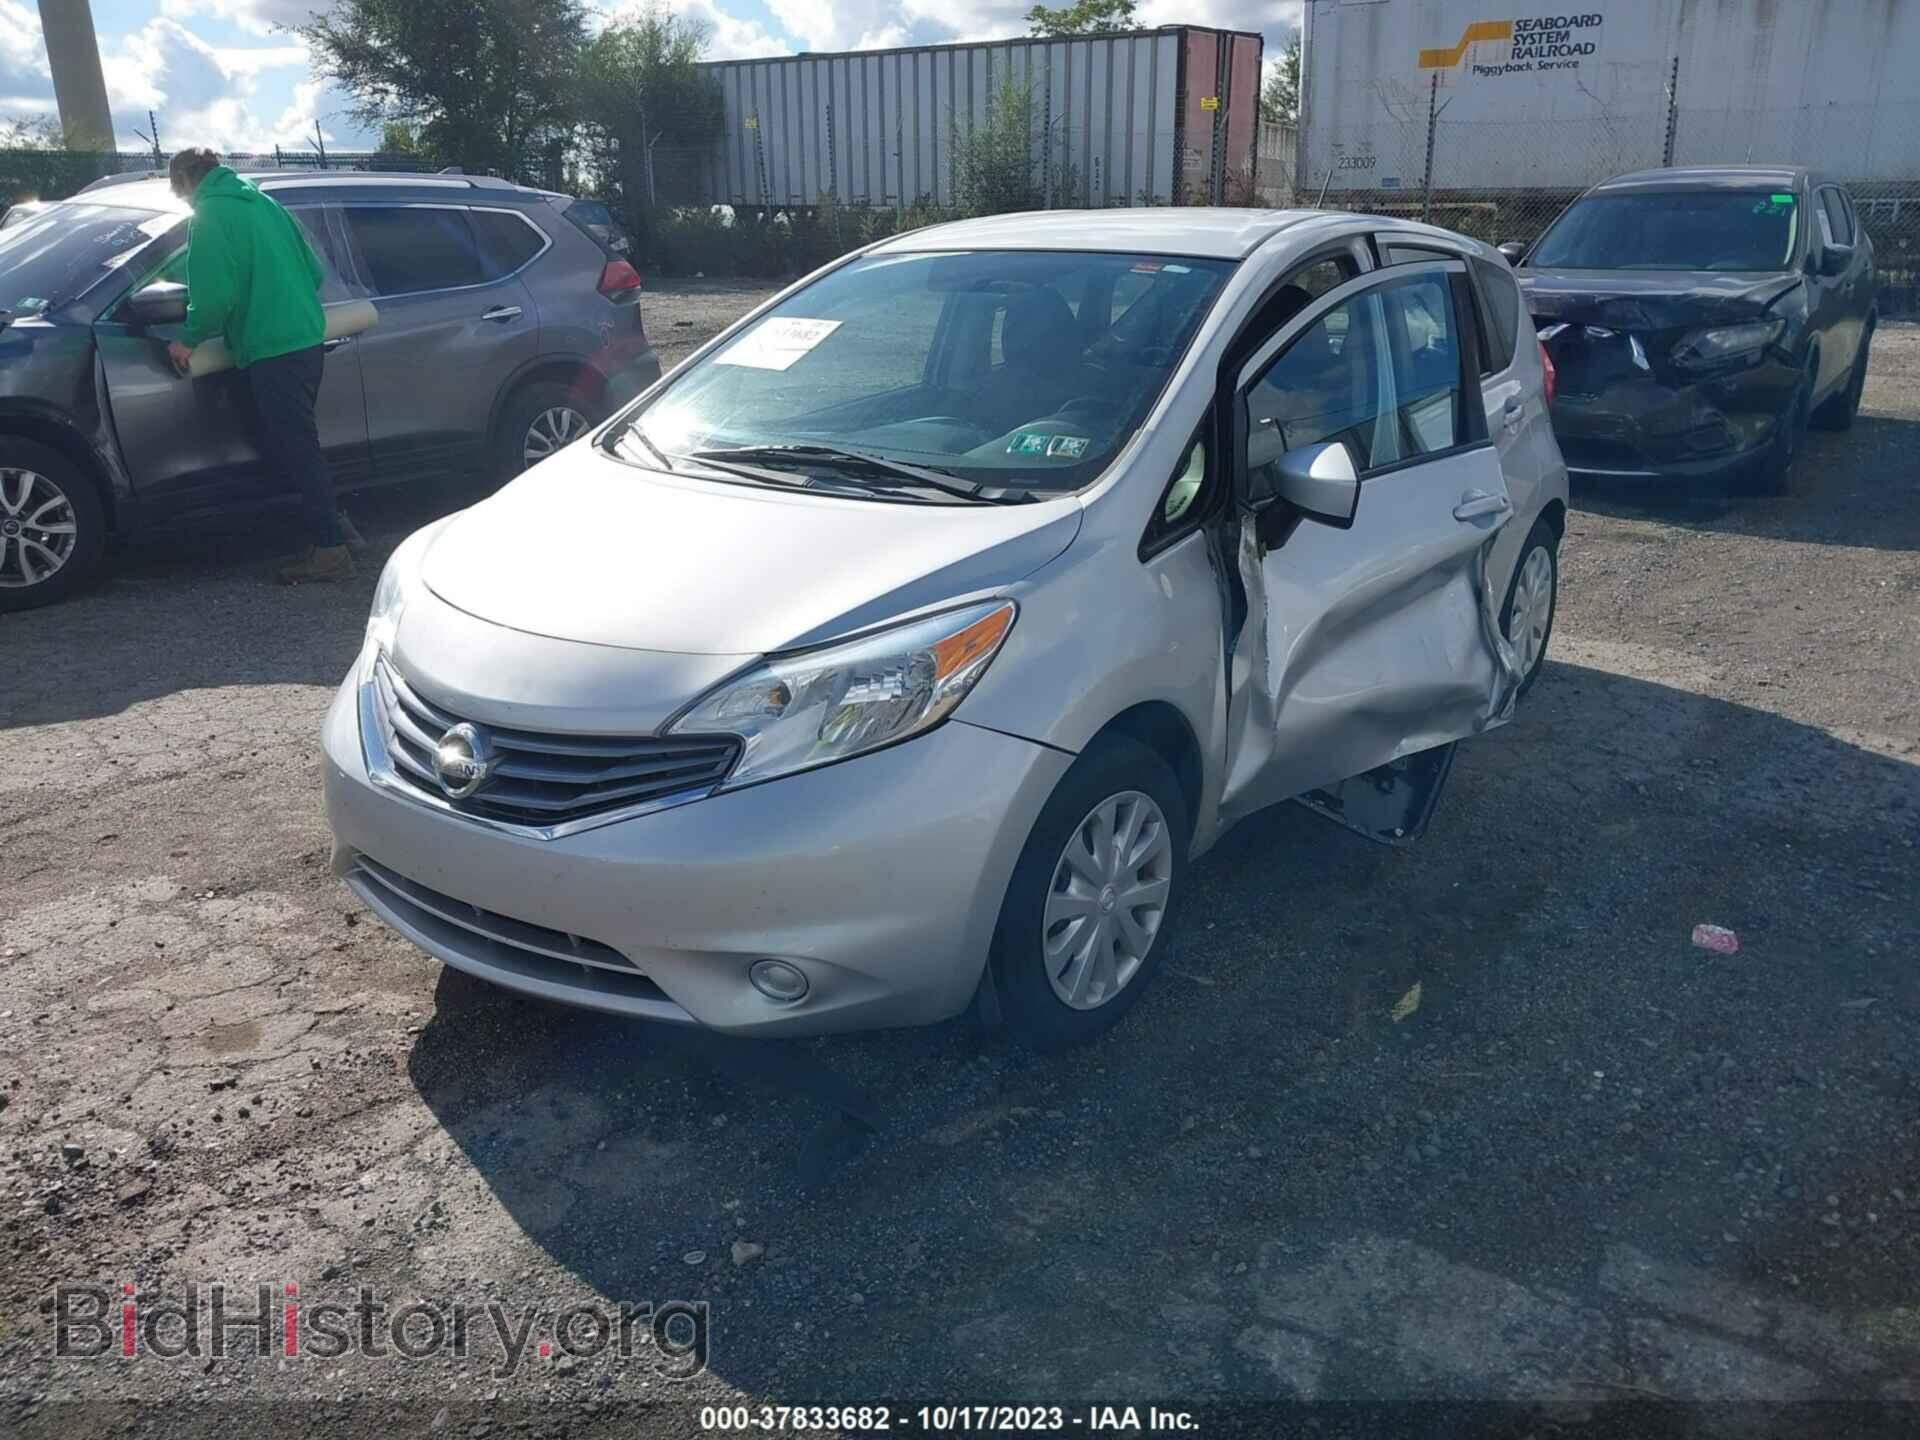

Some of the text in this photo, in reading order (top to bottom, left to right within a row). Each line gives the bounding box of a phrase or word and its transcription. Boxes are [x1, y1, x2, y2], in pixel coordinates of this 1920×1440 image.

[1515, 14, 1602, 32] SEABOARD
[1513, 30, 1570, 46] SYSTEM
[1511, 42, 1595, 60] RAILROAD
[1473, 60, 1579, 77] Piggyback Service
